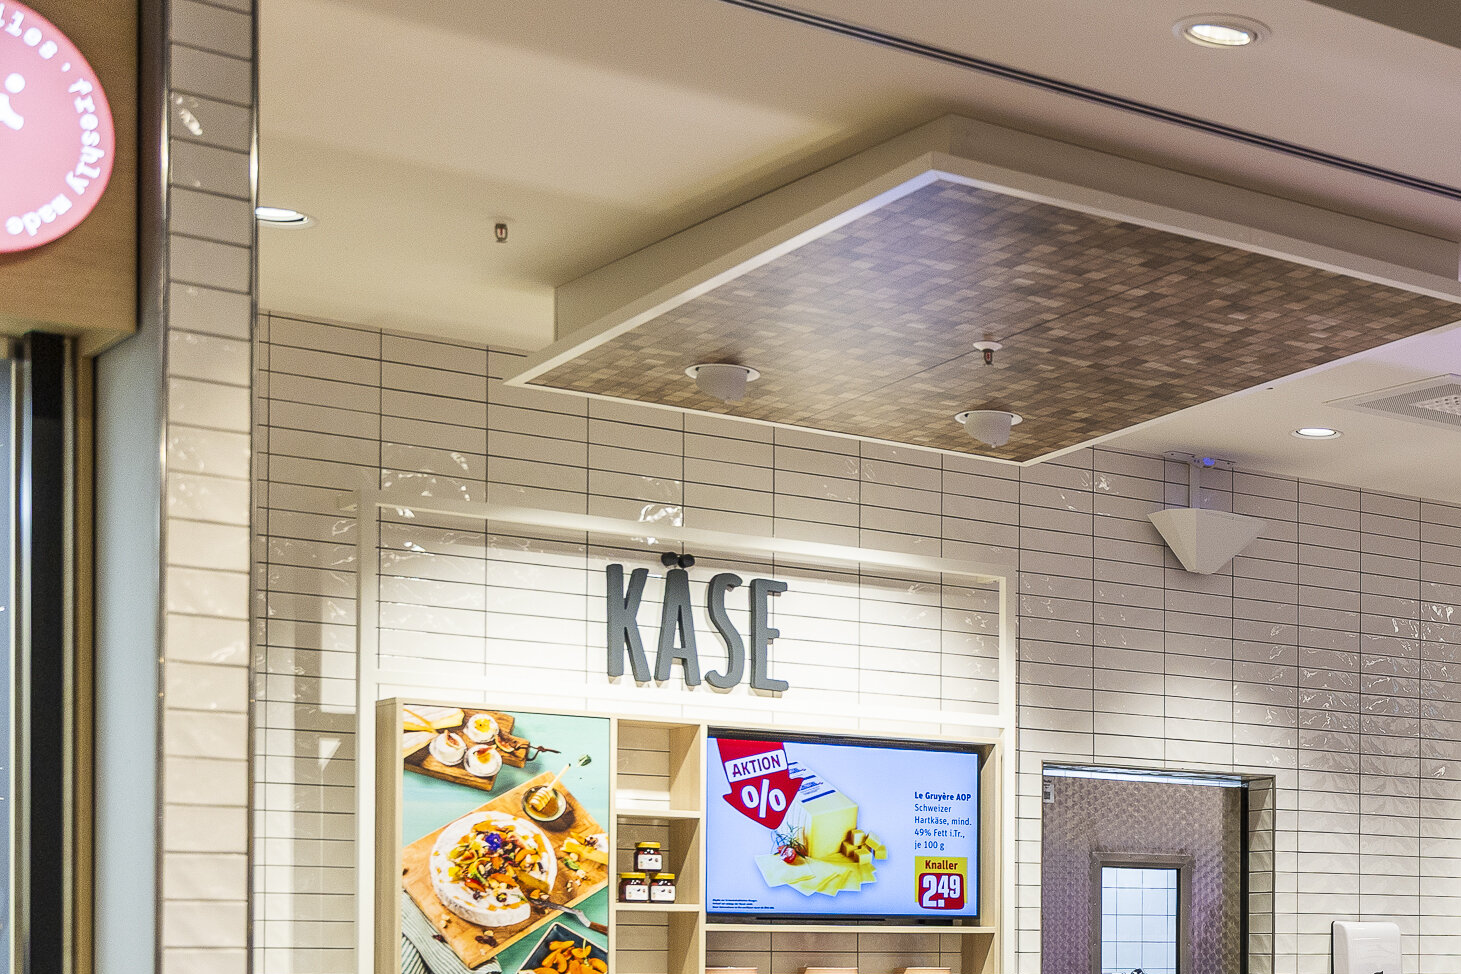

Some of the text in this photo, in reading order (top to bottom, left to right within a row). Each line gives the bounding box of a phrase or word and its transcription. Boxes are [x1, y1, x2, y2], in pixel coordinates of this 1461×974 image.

[0, 3, 58, 60] les
[6, 78, 104, 236] freshly made
[606, 552, 789, 691] KÄSE
[732, 754, 781, 778] AKTION
[914, 791, 972, 801] Le Gruyère AOP
[914, 803, 952, 813] Schweizer
[914, 815, 972, 826] Hartkäse, mind.
[914, 828, 932, 837] 49%
[933, 828, 948, 838] Fett
[914, 840, 945, 851] je 100 g
[925, 859, 958, 870] Knaller
[922, 874, 961, 908] 2.49
